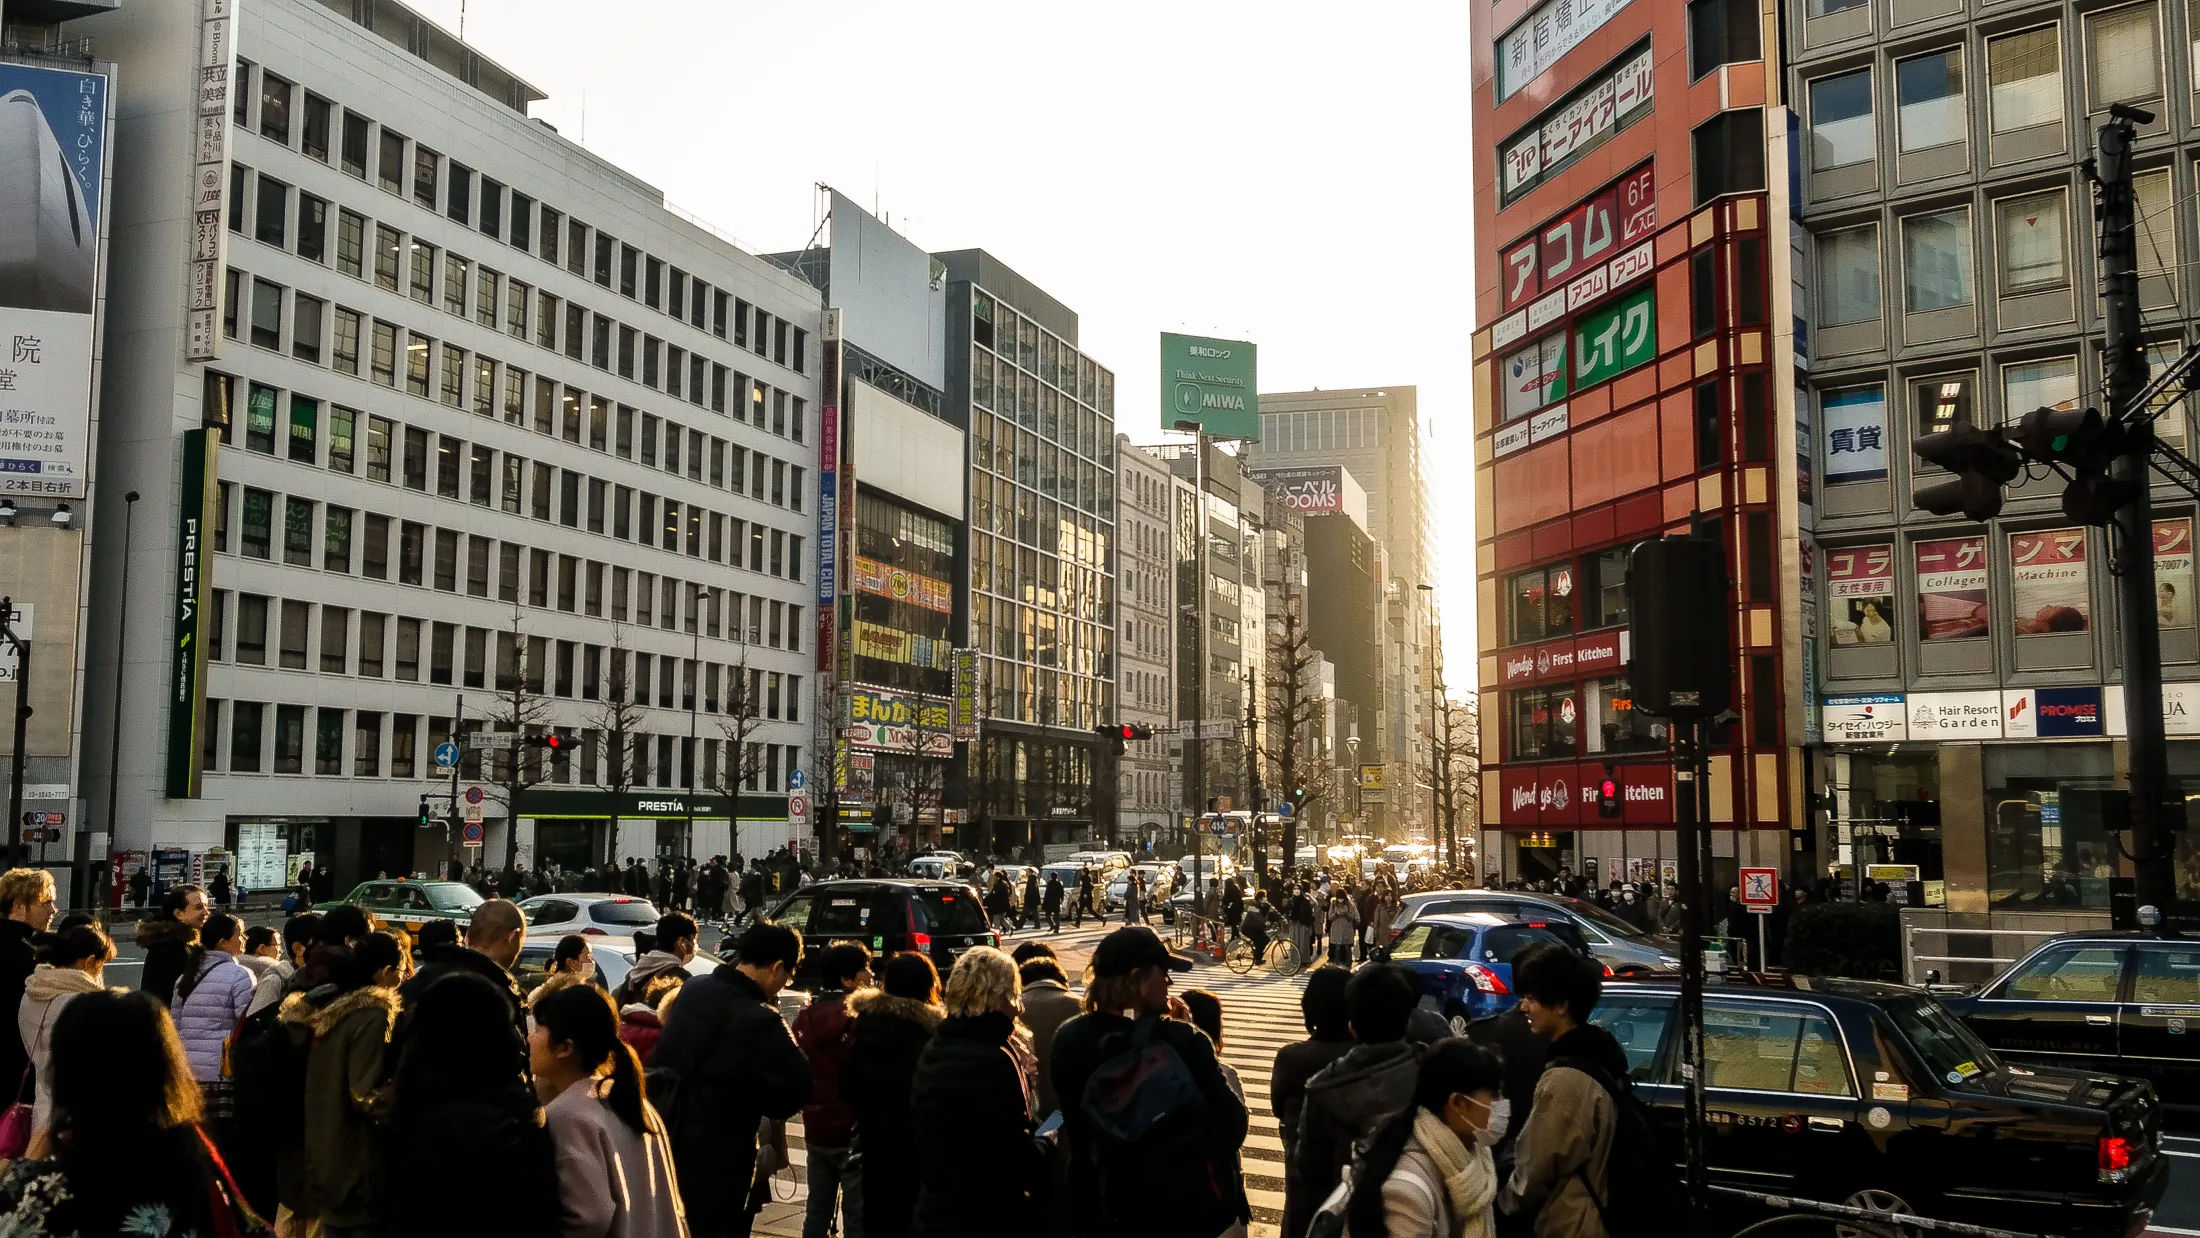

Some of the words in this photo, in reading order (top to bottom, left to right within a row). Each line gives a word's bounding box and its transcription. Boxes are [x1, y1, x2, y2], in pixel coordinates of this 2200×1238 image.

[211, 32, 221, 65] Bloom
[202, 68, 227, 84] 共立
[201, 86, 227, 103] 美容
[77, 78, 96, 189] 白き華、ひらく。
[1541, 69, 1653, 168] エーアイアール
[1627, 171, 1651, 206] 6F
[196, 211, 219, 225] KEN
[196, 224, 206, 259] スクール
[207, 223, 218, 257] パソコン
[1510, 204, 1613, 303] アコム
[1614, 250, 1649, 283] アコム
[194, 263, 204, 307] クリニック
[1572, 273, 1604, 306] アコム
[12, 334, 42, 364] 院
[1188, 344, 1231, 360] 美和ロック
[1575, 300, 1650, 379] レイク
[1174, 369, 1197, 380] Think
[1198, 372, 1215, 382] Next
[1215, 374, 1245, 387] Security
[1202, 392, 1246, 411] MIWA
[0, 428, 64, 441] が不要のお墓
[0, 441, 63, 453] 用権付のお墓
[1828, 424, 1882, 456] 賃貸
[822, 493, 834, 531] JAPAN
[1283, 492, 1337, 509] OOMS
[821, 534, 833, 565] TOTAL
[1830, 550, 1890, 577] コラ
[2015, 534, 2083, 563] ンマ
[2157, 527, 2187, 552] ン
[820, 567, 833, 599] CLUB
[1837, 581, 1885, 595] 女性専用
[1926, 575, 1985, 588] Collagen
[2016, 568, 2078, 581] Machine
[1506, 654, 1534, 680] Wendy's
[1552, 652, 1574, 667] First
[1577, 646, 1613, 662] Kitchen
[1612, 698, 1632, 712] Firs
[1939, 705, 1961, 716] Hair
[1963, 704, 1998, 715] Resort
[2039, 703, 2097, 717] PROMISE
[1939, 717, 1999, 729] Garden
[1512, 781, 1552, 812] Wendy's
[1582, 786, 1599, 803] Fir
[1624, 784, 1664, 801] itchen
[36, 813, 46, 823] 20
[1211, 822, 1225, 830] 414
[1737, 1115, 1777, 1128] 6572
